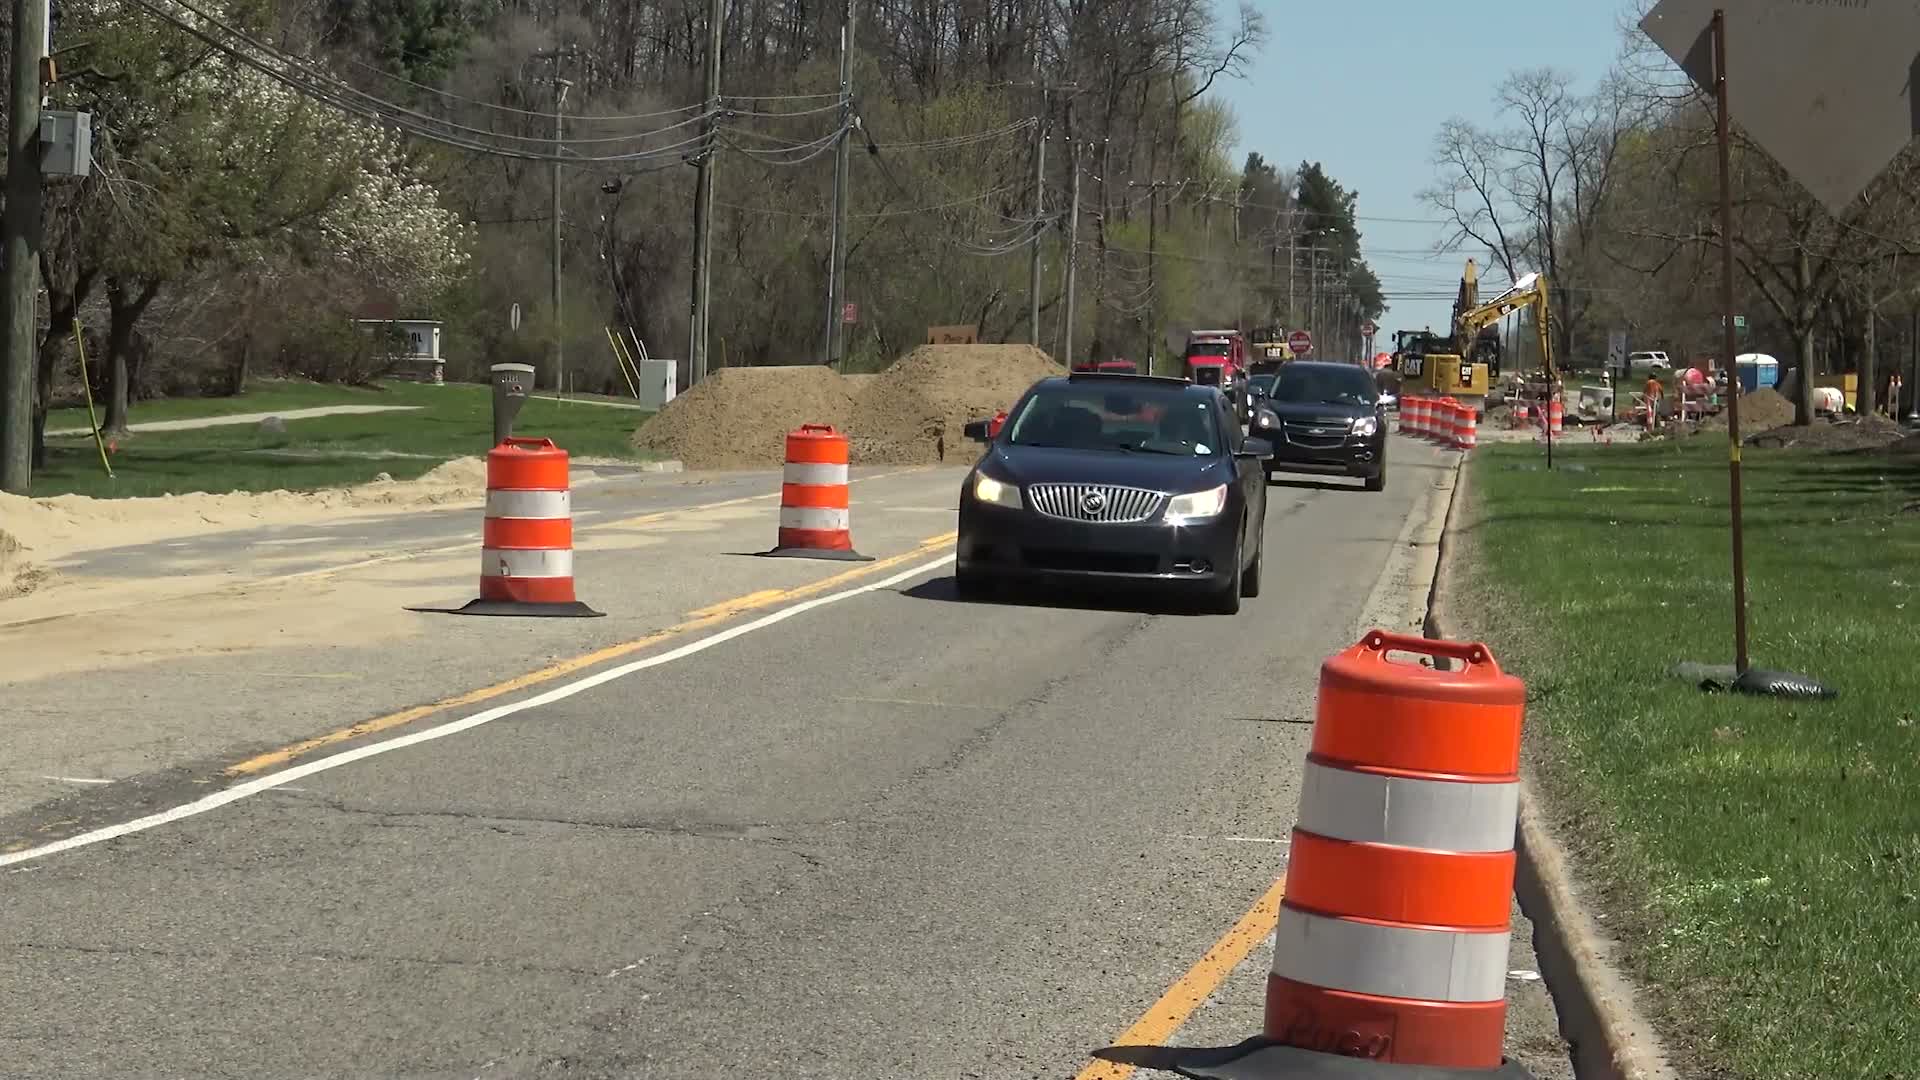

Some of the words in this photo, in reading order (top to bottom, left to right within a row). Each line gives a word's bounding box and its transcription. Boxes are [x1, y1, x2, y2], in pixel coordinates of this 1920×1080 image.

[1267, 348, 1281, 357] CAT
[1404, 359, 1423, 376] CAT
[1461, 366, 1472, 375] CAT
